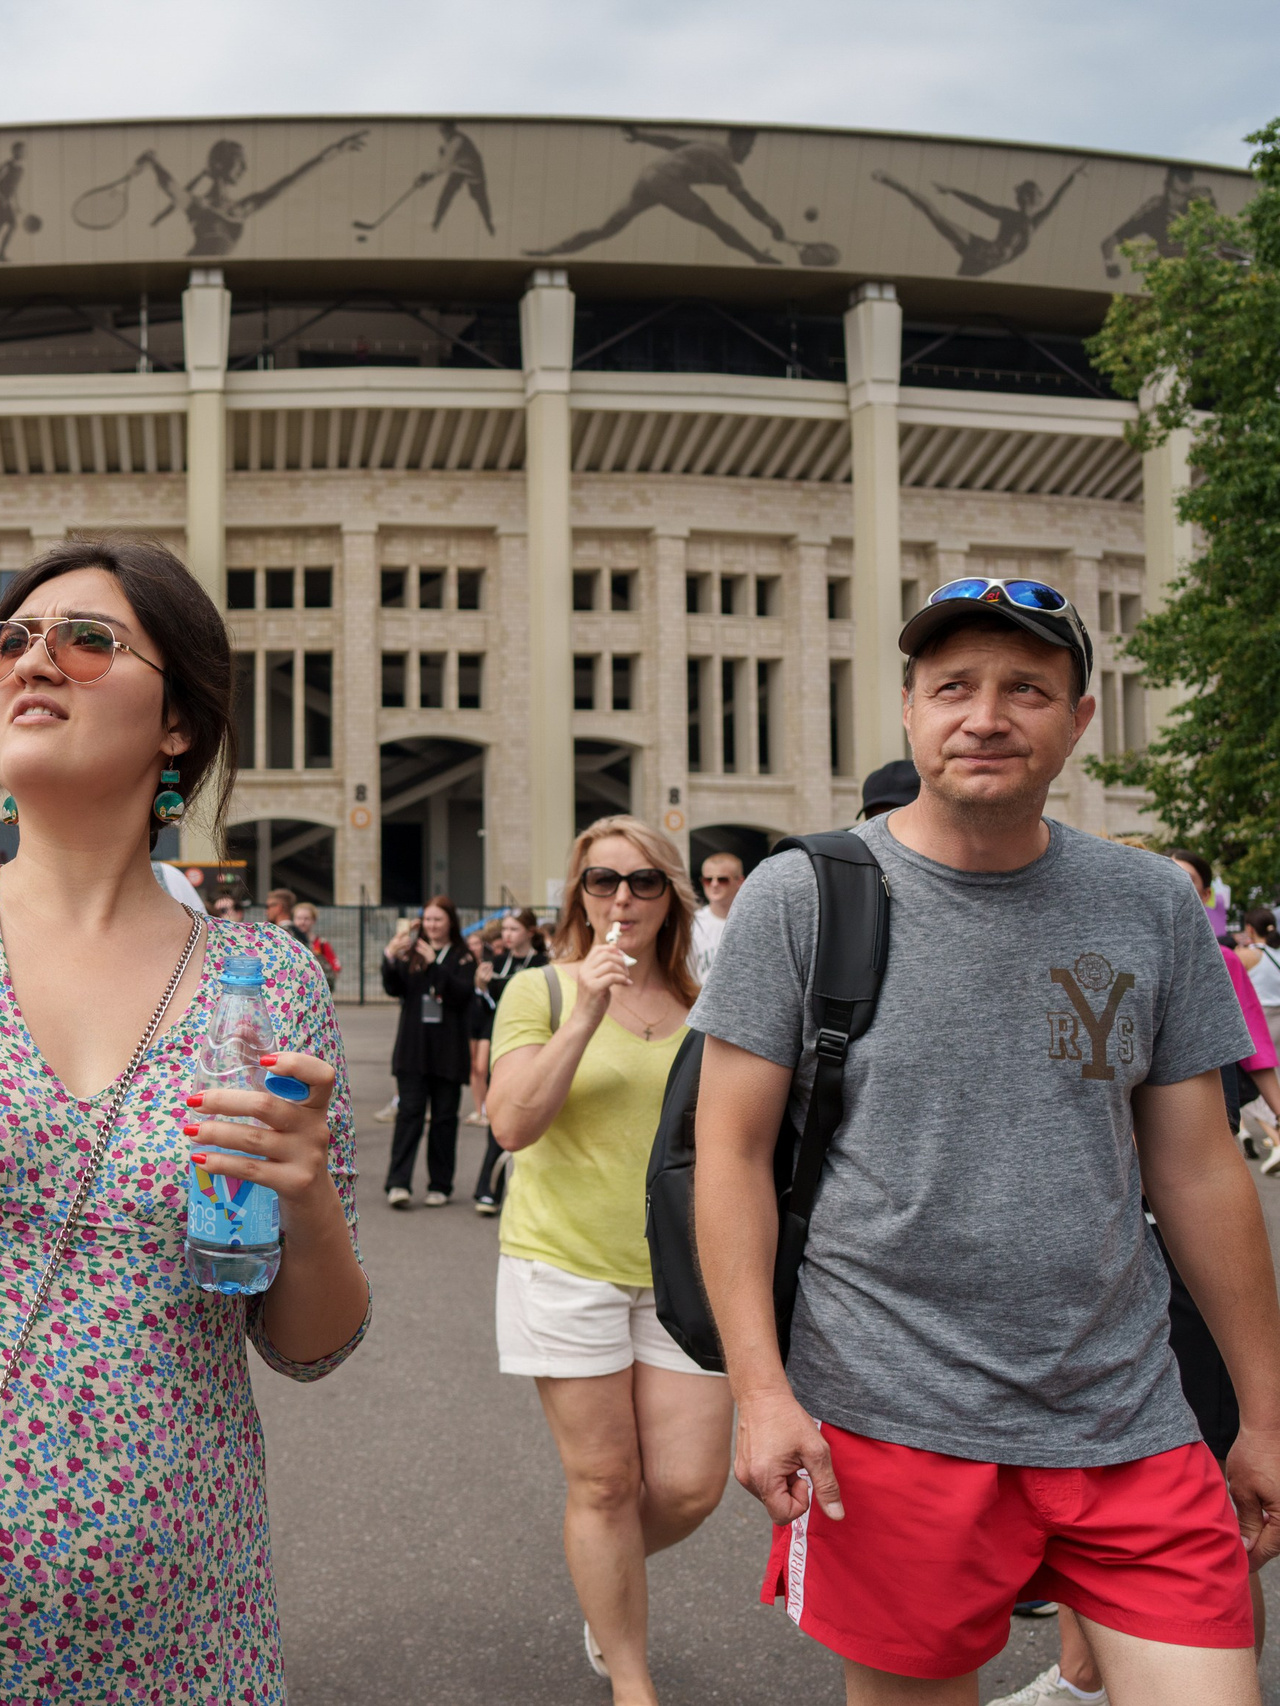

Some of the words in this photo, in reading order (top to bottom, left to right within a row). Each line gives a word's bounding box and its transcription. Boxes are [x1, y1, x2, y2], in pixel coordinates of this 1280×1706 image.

[355, 783, 368, 802] 8
[669, 787, 680, 805] 8
[787, 1541, 806, 1622] EMPORIO
